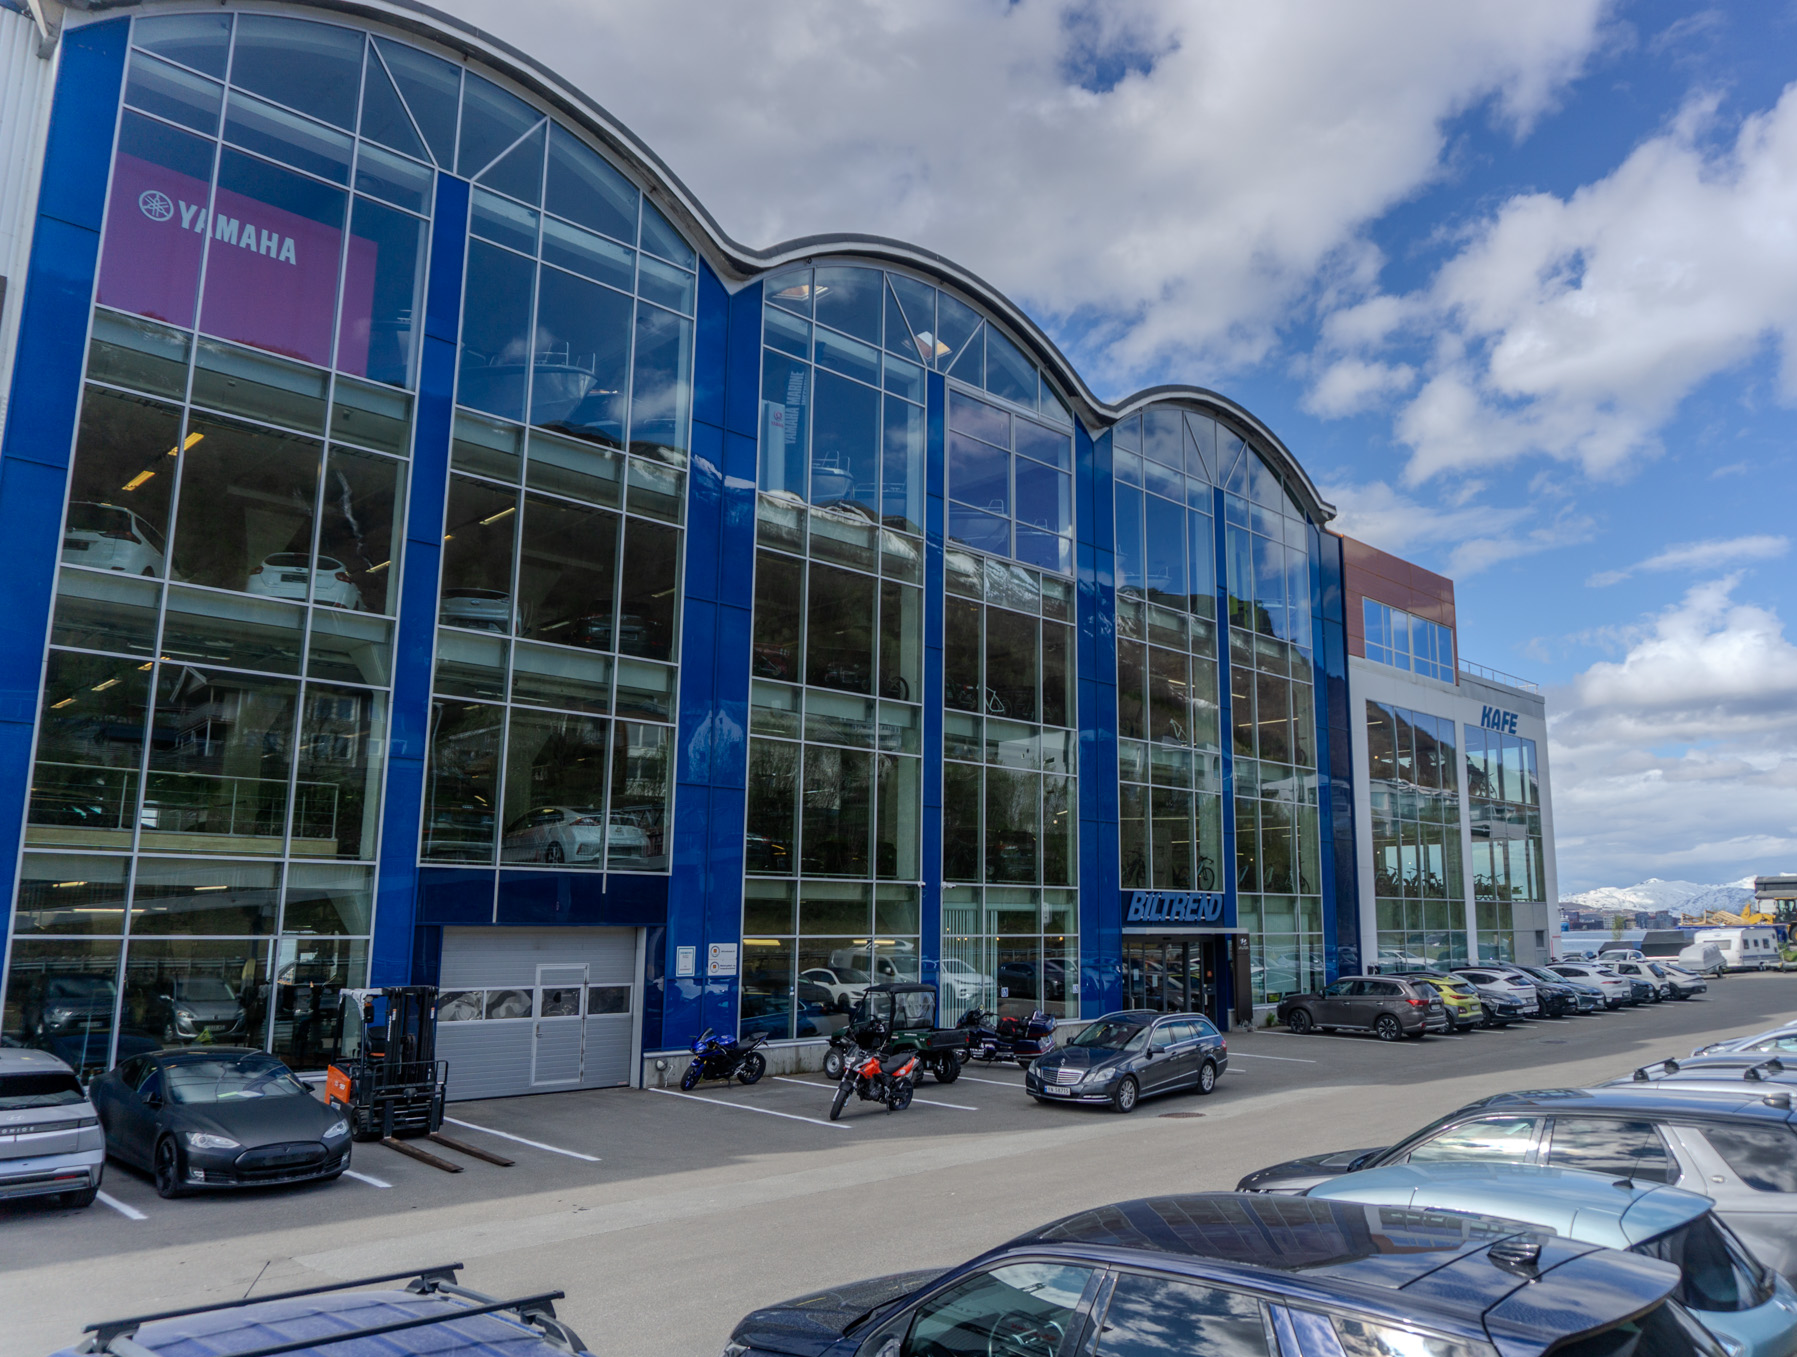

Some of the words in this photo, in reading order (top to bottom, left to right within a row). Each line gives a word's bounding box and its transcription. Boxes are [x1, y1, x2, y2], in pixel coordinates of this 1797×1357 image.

[178, 200, 297, 265] YAMAHA
[786, 370, 805, 406] MARINE
[784, 407, 800, 444] YAMAHA
[1481, 705, 1519, 735] KAFE
[1127, 891, 1223, 921] BILTREND
